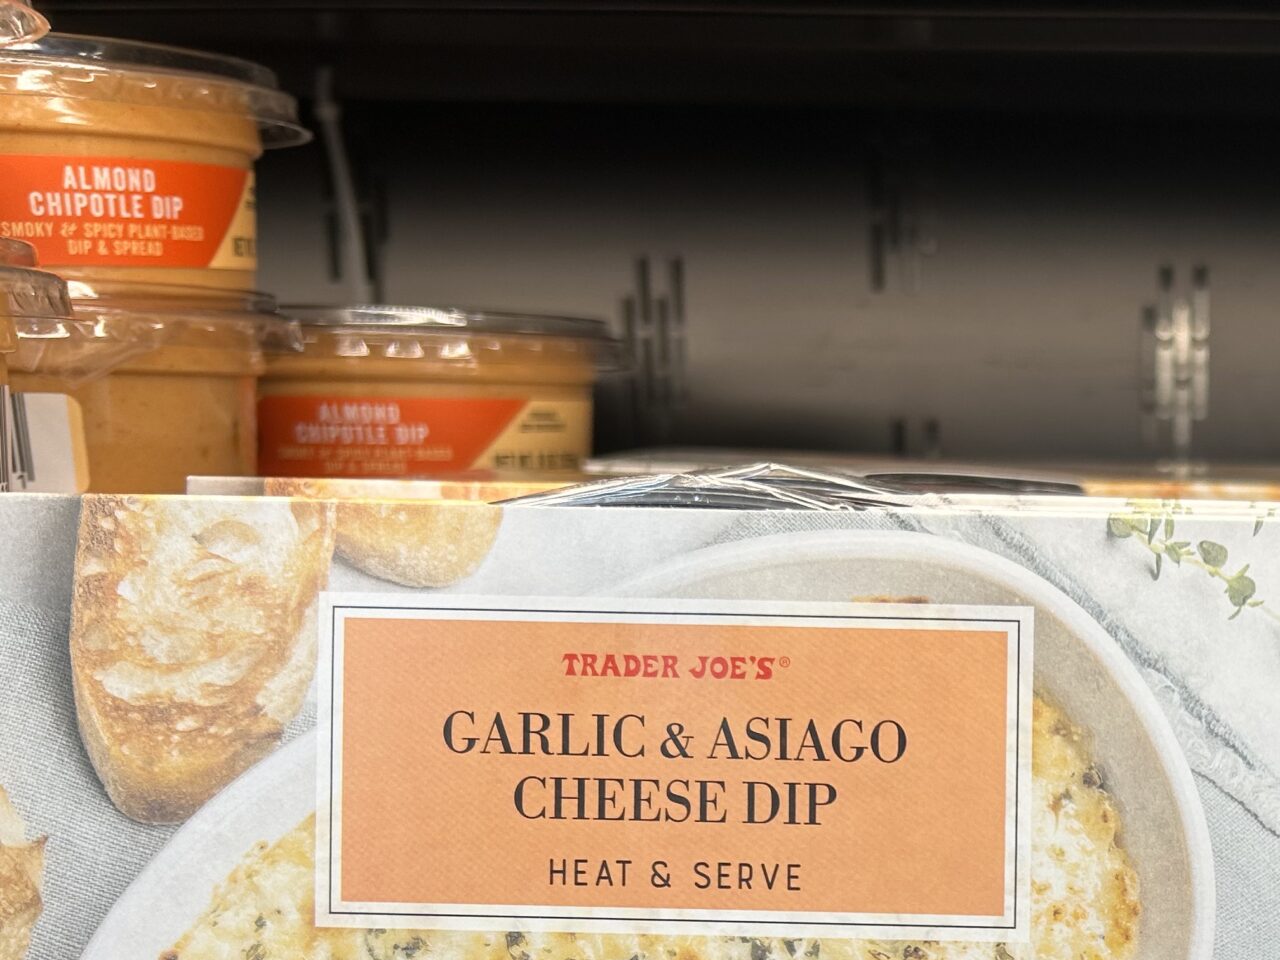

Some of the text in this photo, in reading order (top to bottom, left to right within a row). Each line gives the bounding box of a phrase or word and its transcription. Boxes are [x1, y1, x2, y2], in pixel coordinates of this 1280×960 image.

[62, 165, 156, 193] ALMOND
[28, 190, 184, 220] CHIPOTLE DIP
[0, 221, 54, 238] SMOKY
[84, 224, 124, 239] SPICY
[67, 239, 92, 256] DIP
[113, 240, 164, 256] SPREAD
[562, 653, 679, 678] TRADER
[442, 710, 908, 764] GARLIC & ASIAGO
[513, 776, 838, 825] CHEESE DIP
[548, 858, 802, 891] HEAT & SERVE
